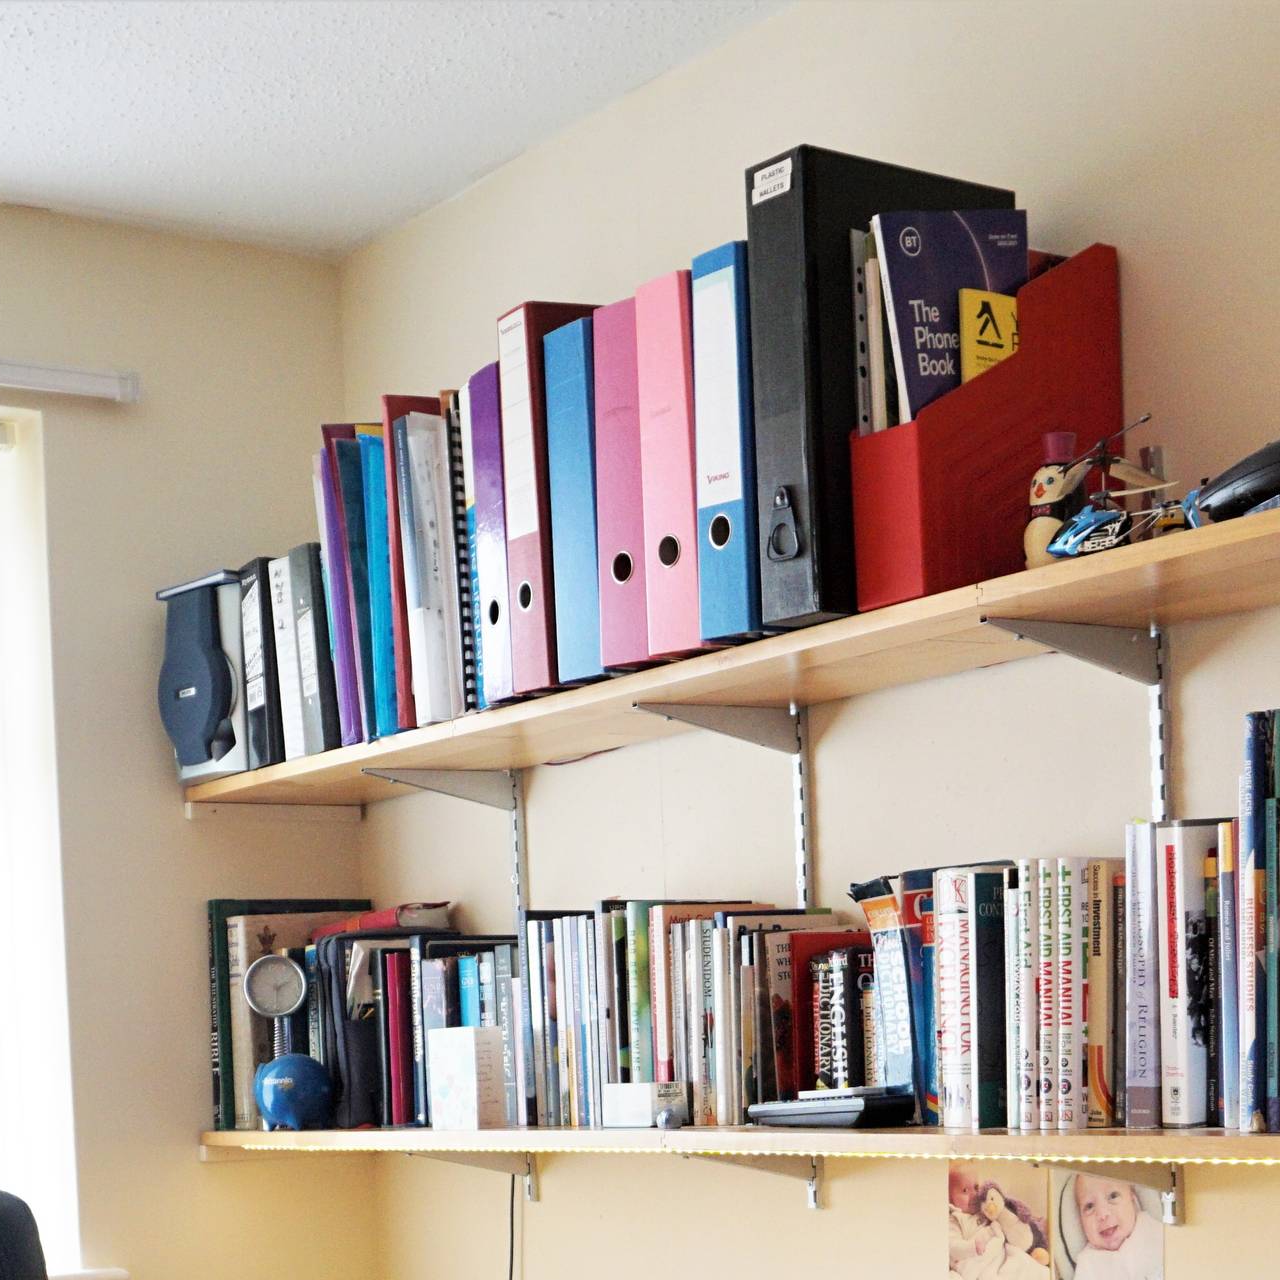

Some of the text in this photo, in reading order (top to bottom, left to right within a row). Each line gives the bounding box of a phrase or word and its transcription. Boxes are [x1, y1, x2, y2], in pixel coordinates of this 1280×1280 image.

[904, 235, 918, 248] BT
[907, 299, 941, 324] The
[913, 326, 960, 350] Phone
[917, 352, 956, 377] Book
[1244, 792, 1255, 817] GCSE
[1091, 864, 1102, 891] Success
[1058, 884, 1073, 928] FIRST
[1091, 899, 1104, 957] Investment
[1222, 899, 1232, 924] Romeo
[1023, 890, 1033, 969] First Aid
[1058, 932, 1073, 957] AID
[1223, 942, 1233, 961] Juliet
[1041, 886, 1055, 1028] FIRST AID MANUAL
[1245, 897, 1257, 1013] BUSINESS STUDIES
[879, 951, 900, 1057] DICTIONARY
[891, 950, 912, 1055] SCHOOL
[939, 918, 958, 1057] EXCELLENCE
[959, 918, 972, 1056] MANAGING FOR
[1058, 959, 1073, 1026] MANUAL
[819, 983, 833, 1075] DICTIONARY
[827, 970, 849, 1081] ENGLISH
[863, 1005, 876, 1082] DICTIONARY
[1138, 1003, 1150, 1079] RELIGION
[210, 1031, 221, 1076] BIBLE
[631, 1039, 642, 1073] WINS
[1245, 1059, 1255, 1084] Study
[1246, 1085, 1255, 1106] Guide
